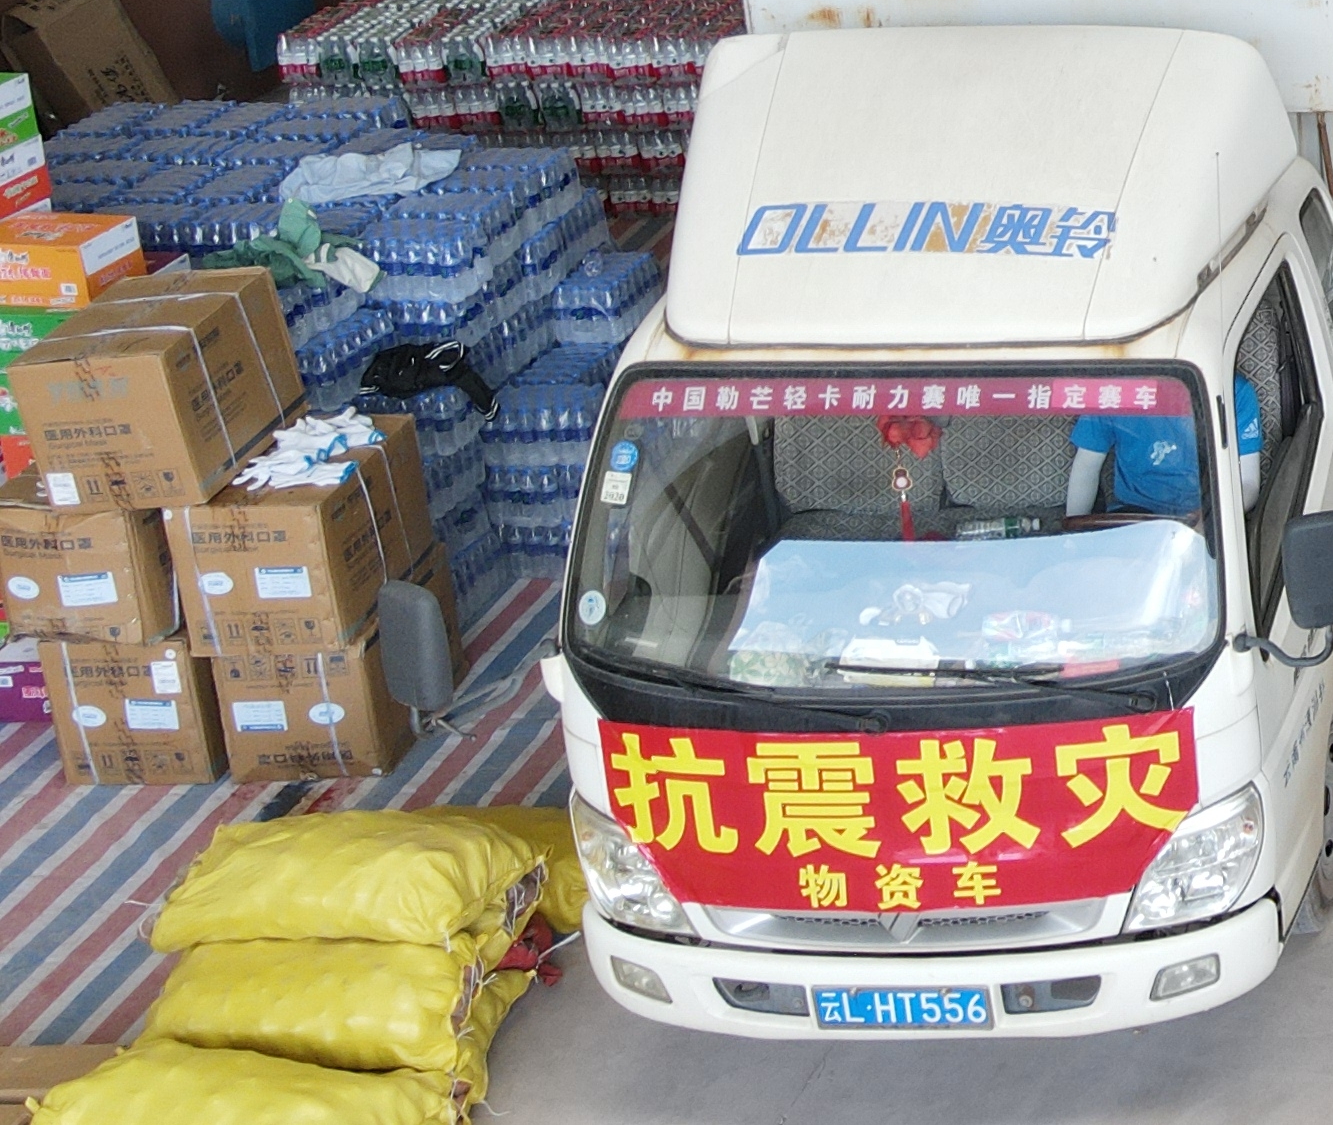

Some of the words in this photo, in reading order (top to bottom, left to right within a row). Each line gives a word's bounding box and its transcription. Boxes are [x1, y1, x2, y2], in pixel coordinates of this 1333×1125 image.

[736, 202, 987, 256] OLLIN
[979, 203, 1118, 260] 奥铃
[651, 384, 1160, 412] 中国勒芒轻卡耐力赛唯一指定赛车
[44, 424, 132, 441] 医用外科口罩
[611, 725, 1192, 858] 抗震救灾
[800, 860, 1002, 910] 物资车
[819, 988, 987, 1026] 云L·HT556
